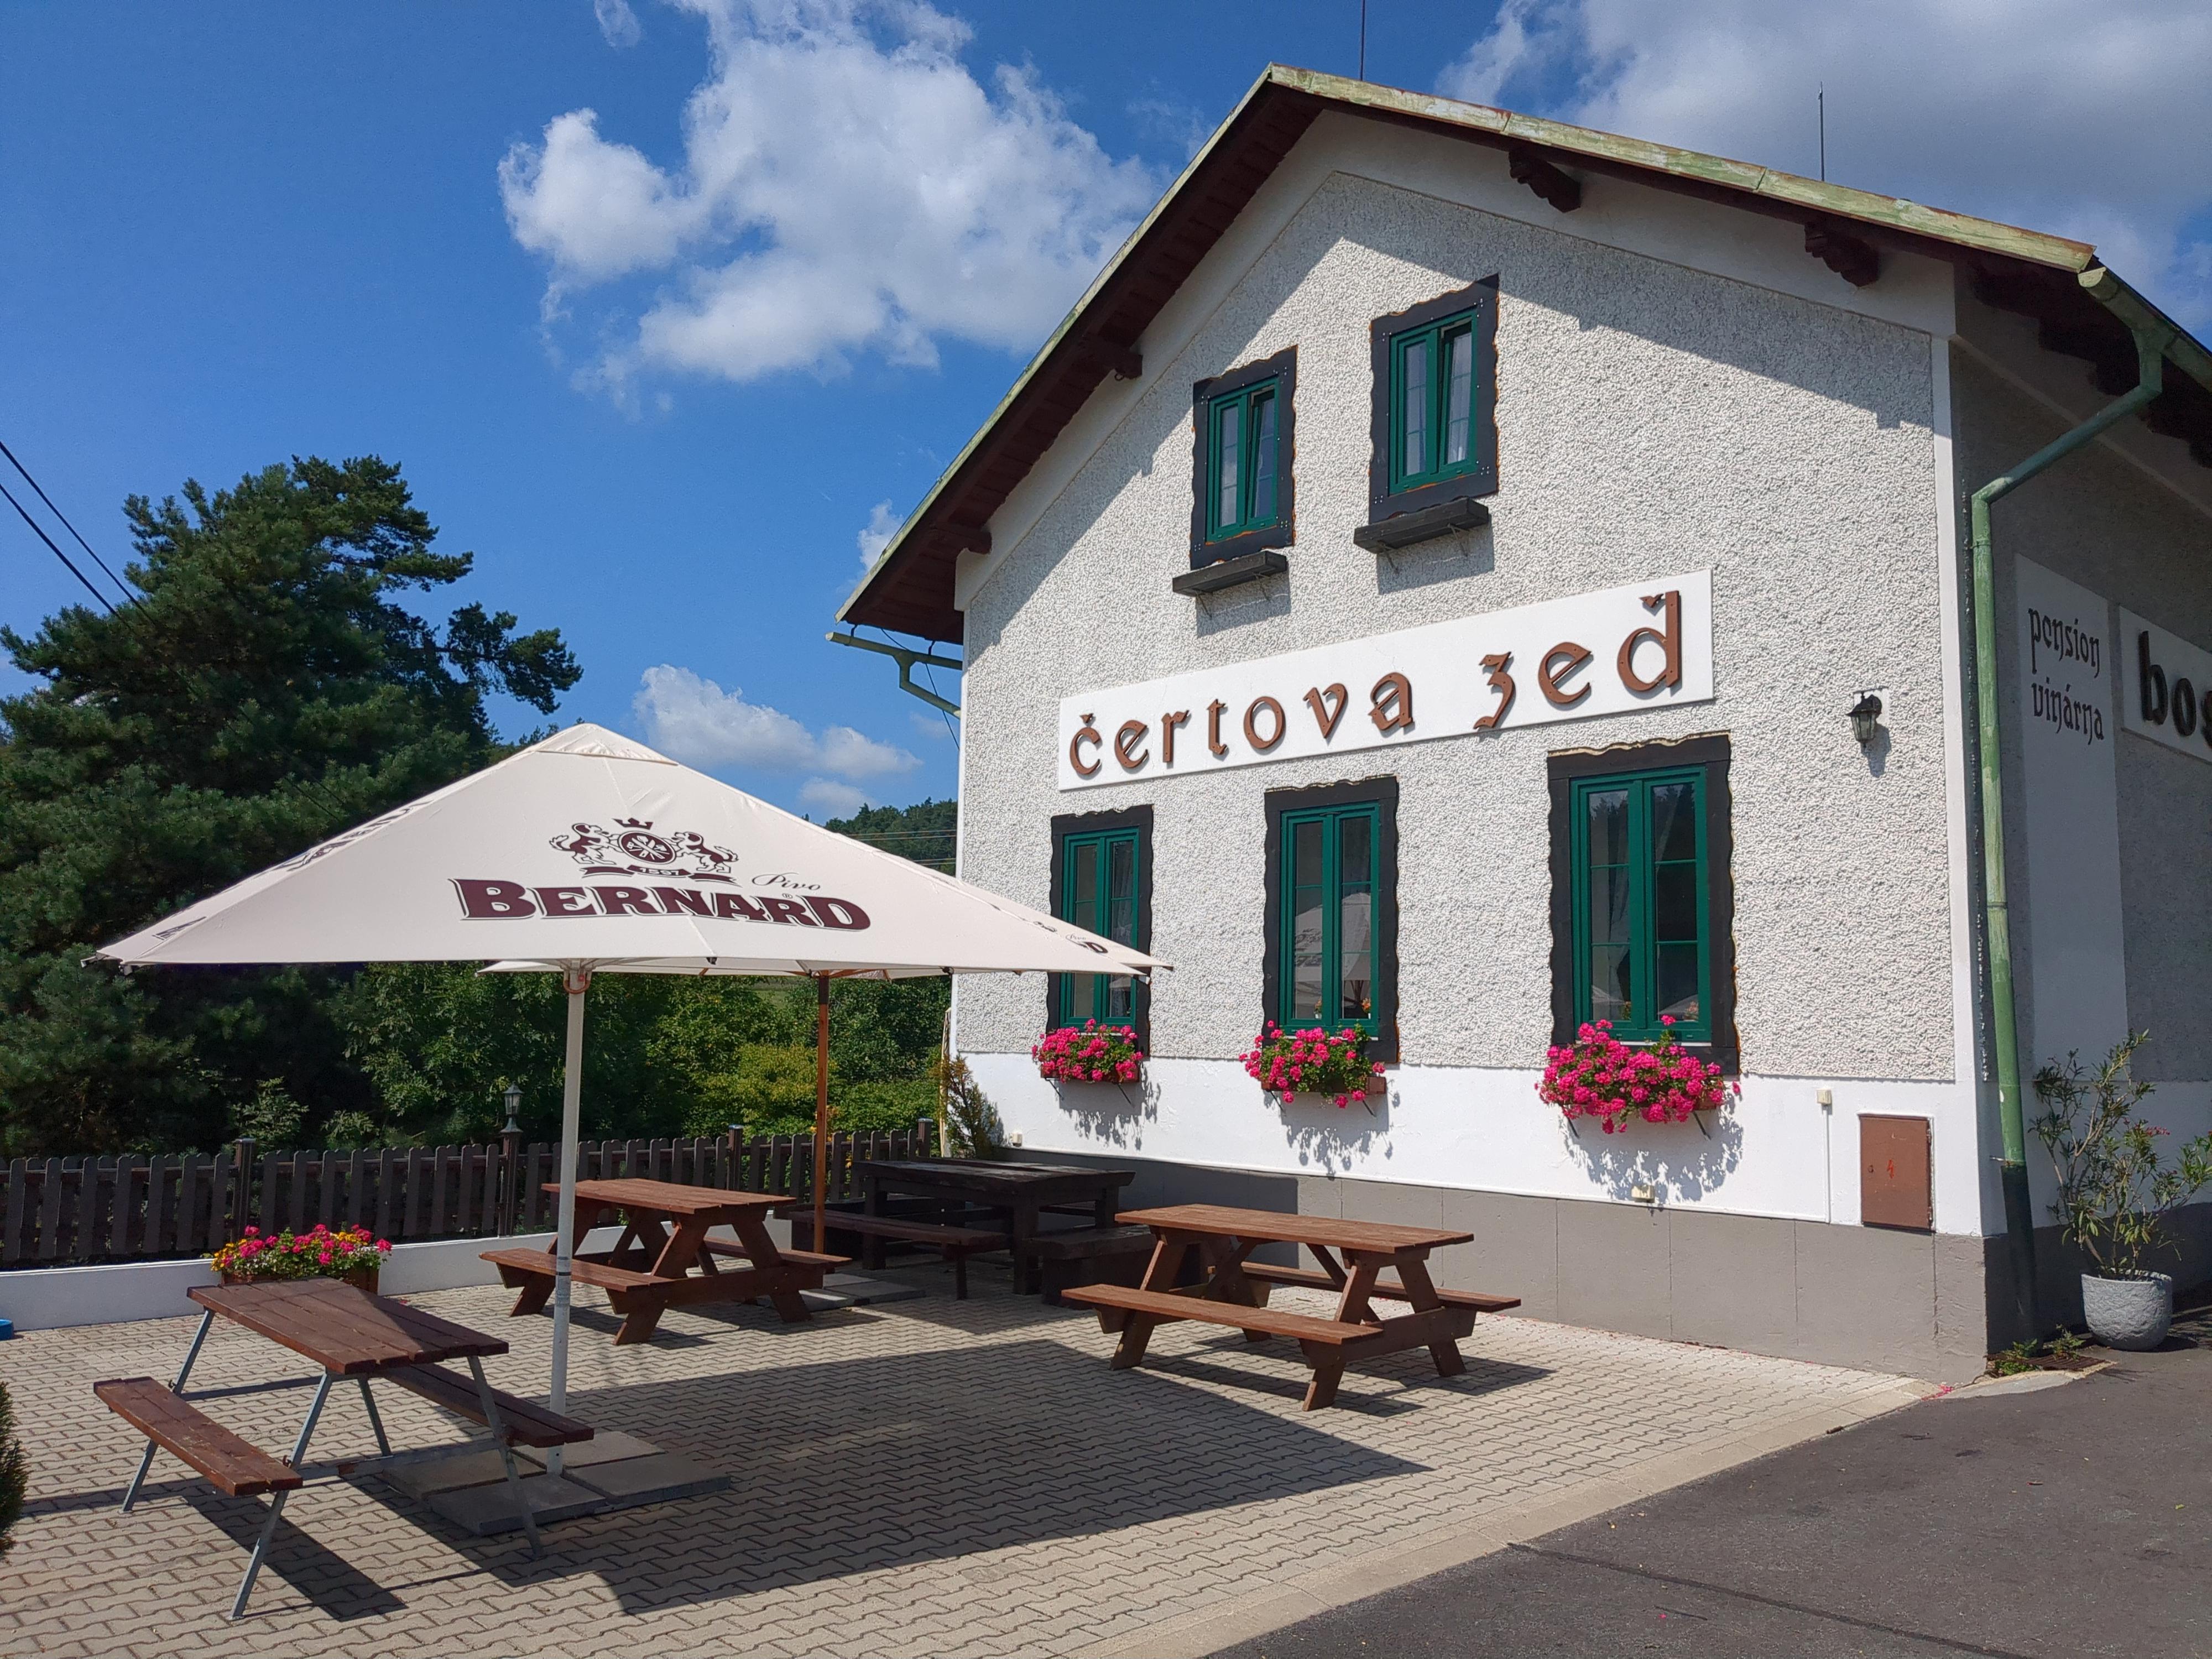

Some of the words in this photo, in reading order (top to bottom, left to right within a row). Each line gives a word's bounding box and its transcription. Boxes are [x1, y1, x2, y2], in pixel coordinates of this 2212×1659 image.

[2028, 608, 2100, 679] pension
[1070, 671, 1413, 776] čertova
[1474, 589, 1682, 729] zeď
[2031, 677, 2104, 745] vinárna
[447, 878, 872, 933] BERNARD
[752, 872, 821, 891] Pivo
